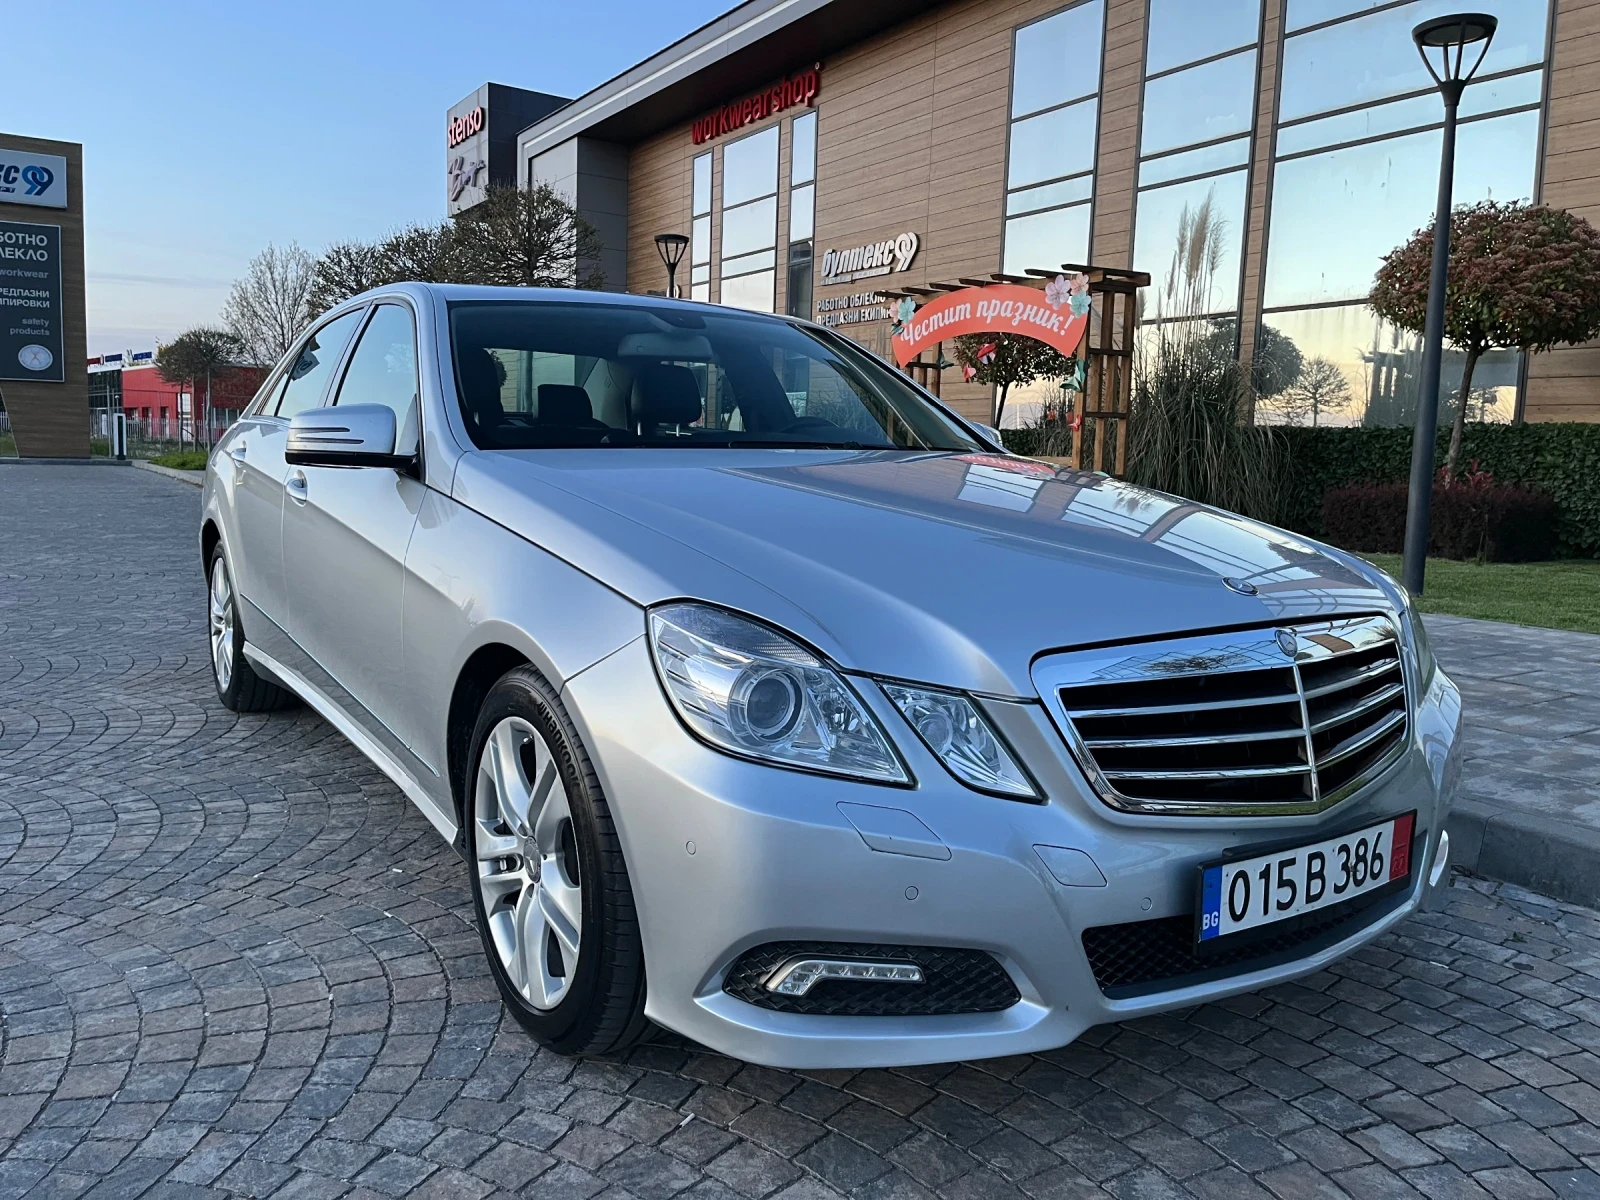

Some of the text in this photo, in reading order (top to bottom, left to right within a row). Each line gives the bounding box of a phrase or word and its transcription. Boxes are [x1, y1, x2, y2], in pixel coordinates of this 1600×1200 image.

[692, 71, 818, 144] workwearshop
[447, 106, 483, 149] stenso
[0, 298, 50, 308] ПИРОВКИ
[817, 295, 848, 312] РАБОТНО
[22, 318, 49, 327] safety
[816, 309, 859, 327] ПРЕДПАЗНИ
[901, 299, 1075, 345] Честит празник!
[10, 328, 50, 336] products
[1202, 911, 1219, 931] BG
